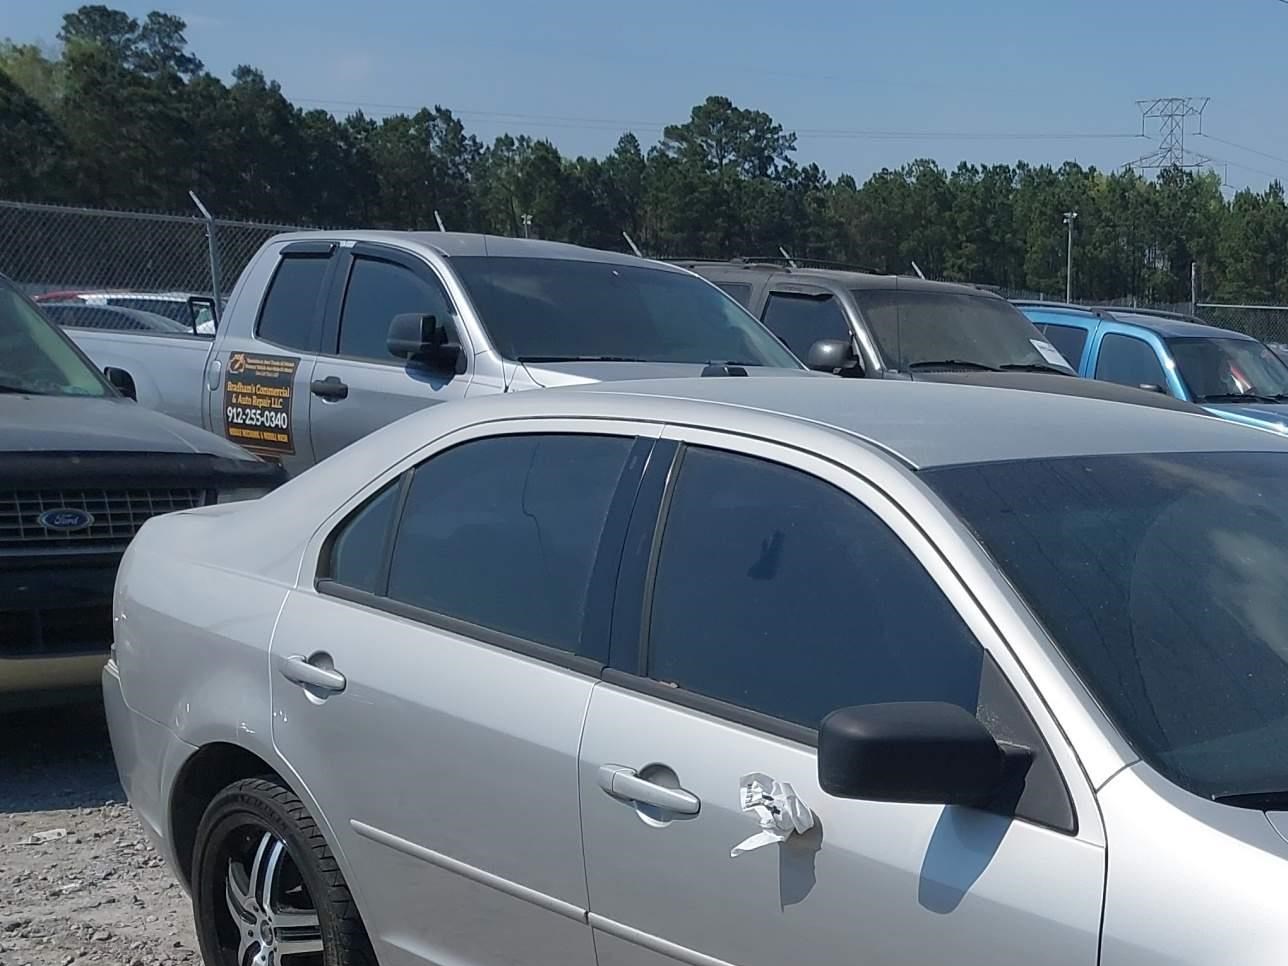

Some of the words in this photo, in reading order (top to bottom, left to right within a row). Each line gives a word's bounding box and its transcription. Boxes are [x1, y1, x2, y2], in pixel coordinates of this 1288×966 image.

[256, 384, 290, 397] Commercial
[232, 395, 237, 404] &
[237, 395, 251, 405] Auto
[252, 396, 271, 408] Repair
[271, 397, 283, 409] LLC
[227, 406, 288, 429] 912-255-0340
[53, 514, 80, 525] Ford
